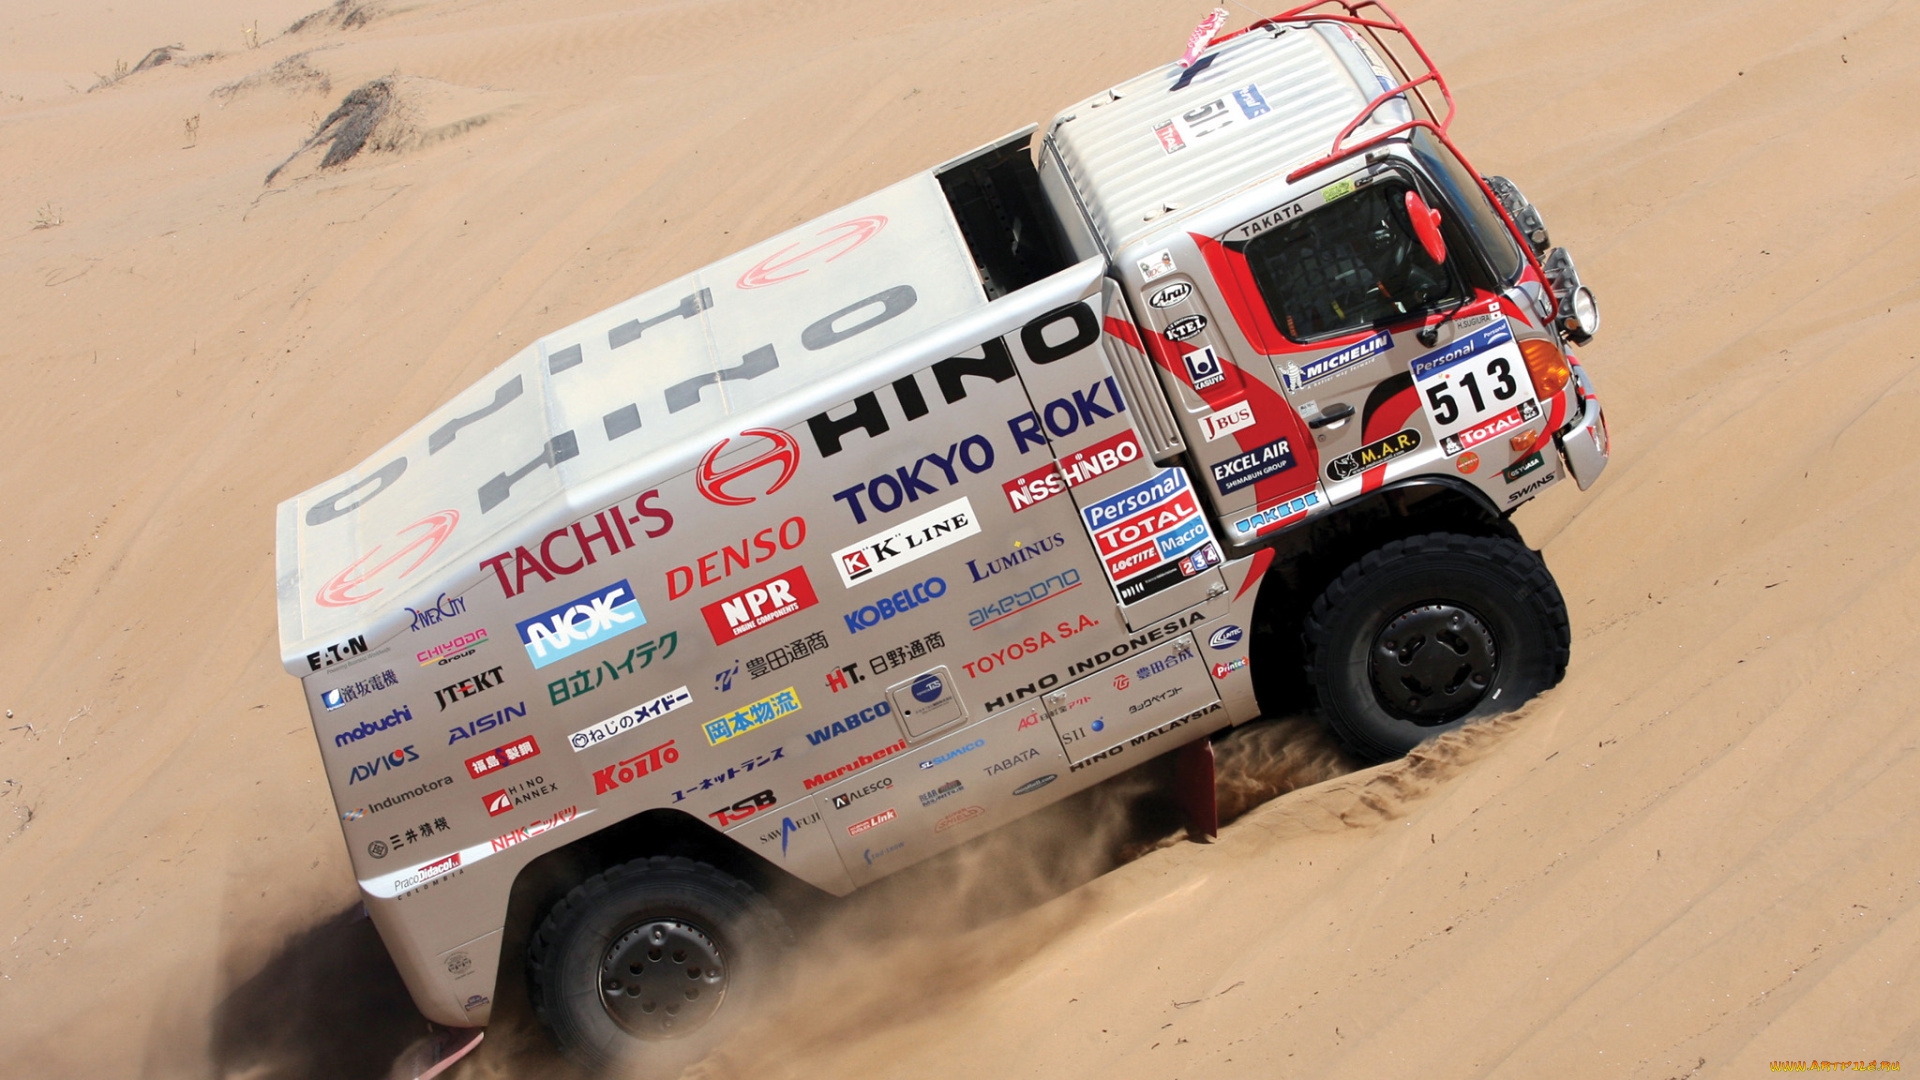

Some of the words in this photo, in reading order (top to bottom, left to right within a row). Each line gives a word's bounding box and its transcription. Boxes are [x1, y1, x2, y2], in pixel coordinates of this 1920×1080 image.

[1241, 203, 1303, 237] TAKATA
[1154, 284, 1187, 306] Arai
[1166, 319, 1206, 341] KTEL
[1307, 335, 1388, 379] MICHELIN
[1416, 340, 1475, 374] Personal
[807, 301, 1100, 458] HINO
[1194, 375, 1224, 391] KASUYA
[1425, 357, 1517, 425] 513
[1461, 415, 1520, 444] TOTAL
[832, 434, 995, 524] TOKYO
[1007, 375, 1126, 455] ROKI
[1214, 454, 1259, 480] EXCEL
[1263, 440, 1290, 463] AIR
[1361, 434, 1416, 465] M.A.R.
[1010, 443, 1137, 510] NISSHINBO
[1225, 470, 1263, 489] SHIMABUN
[1263, 460, 1287, 474] GROUP
[1509, 473, 1555, 502] SWANS
[1090, 468, 1181, 526] Personal
[480, 489, 674, 599] TACHI-S
[907, 513, 969, 549] LINE
[1099, 502, 1194, 548] TOTAL
[1160, 523, 1204, 552] Macro
[665, 516, 807, 601] DENSO
[966, 532, 1065, 583] LUMINUS
[1183, 562, 1195, 575] 2
[1194, 555, 1206, 568] 3
[1206, 546, 1218, 560] 4
[537, 587, 636, 658] NOK
[721, 578, 797, 628] NPR
[733, 617, 757, 636] ENGINE
[756, 602, 799, 626] COMPONENTS
[843, 577, 947, 634] KOBELCO
[306, 634, 369, 671] EATON
[417, 628, 488, 662] CHIYODA
[962, 631, 1056, 679] TOYOSA
[1057, 614, 1099, 639] S.A.
[1222, 627, 1242, 639] LINTEC
[438, 648, 475, 666] Group
[548, 630, 678, 706] 日立ハイテク
[745, 630, 830, 680] 豊田通商
[869, 631, 945, 675] 日野通商
[984, 673, 1058, 713] HINO
[1068, 611, 1207, 676] INDONESIA
[1217, 657, 1246, 677] Printec
[434, 666, 506, 712] JTEKT
[335, 705, 412, 747] mabuchi
[448, 701, 527, 745] AISIN
[589, 692, 690, 743] ねじのメイドー
[705, 689, 800, 744] 岡本物流
[806, 701, 892, 746] WABCO
[1062, 727, 1086, 745] SII
[933, 739, 986, 766] SUMICO
[1070, 746, 1124, 773] HINO
[1130, 702, 1224, 746] MALAYSIA
[349, 745, 420, 785] ADVICS
[672, 747, 785, 804] ユーネットランス
[803, 738, 907, 790] Marubeni
[984, 748, 1040, 776] TABATA
[369, 775, 453, 814] Indumotora
[509, 775, 544, 795] HINO
[515, 782, 558, 806] ANNEX
[849, 777, 893, 802] ALESCO
[708, 788, 777, 827] TSB
[871, 811, 896, 827] Link
[390, 817, 450, 851] 三井精機
[397, 868, 464, 901] COLOMBIA
